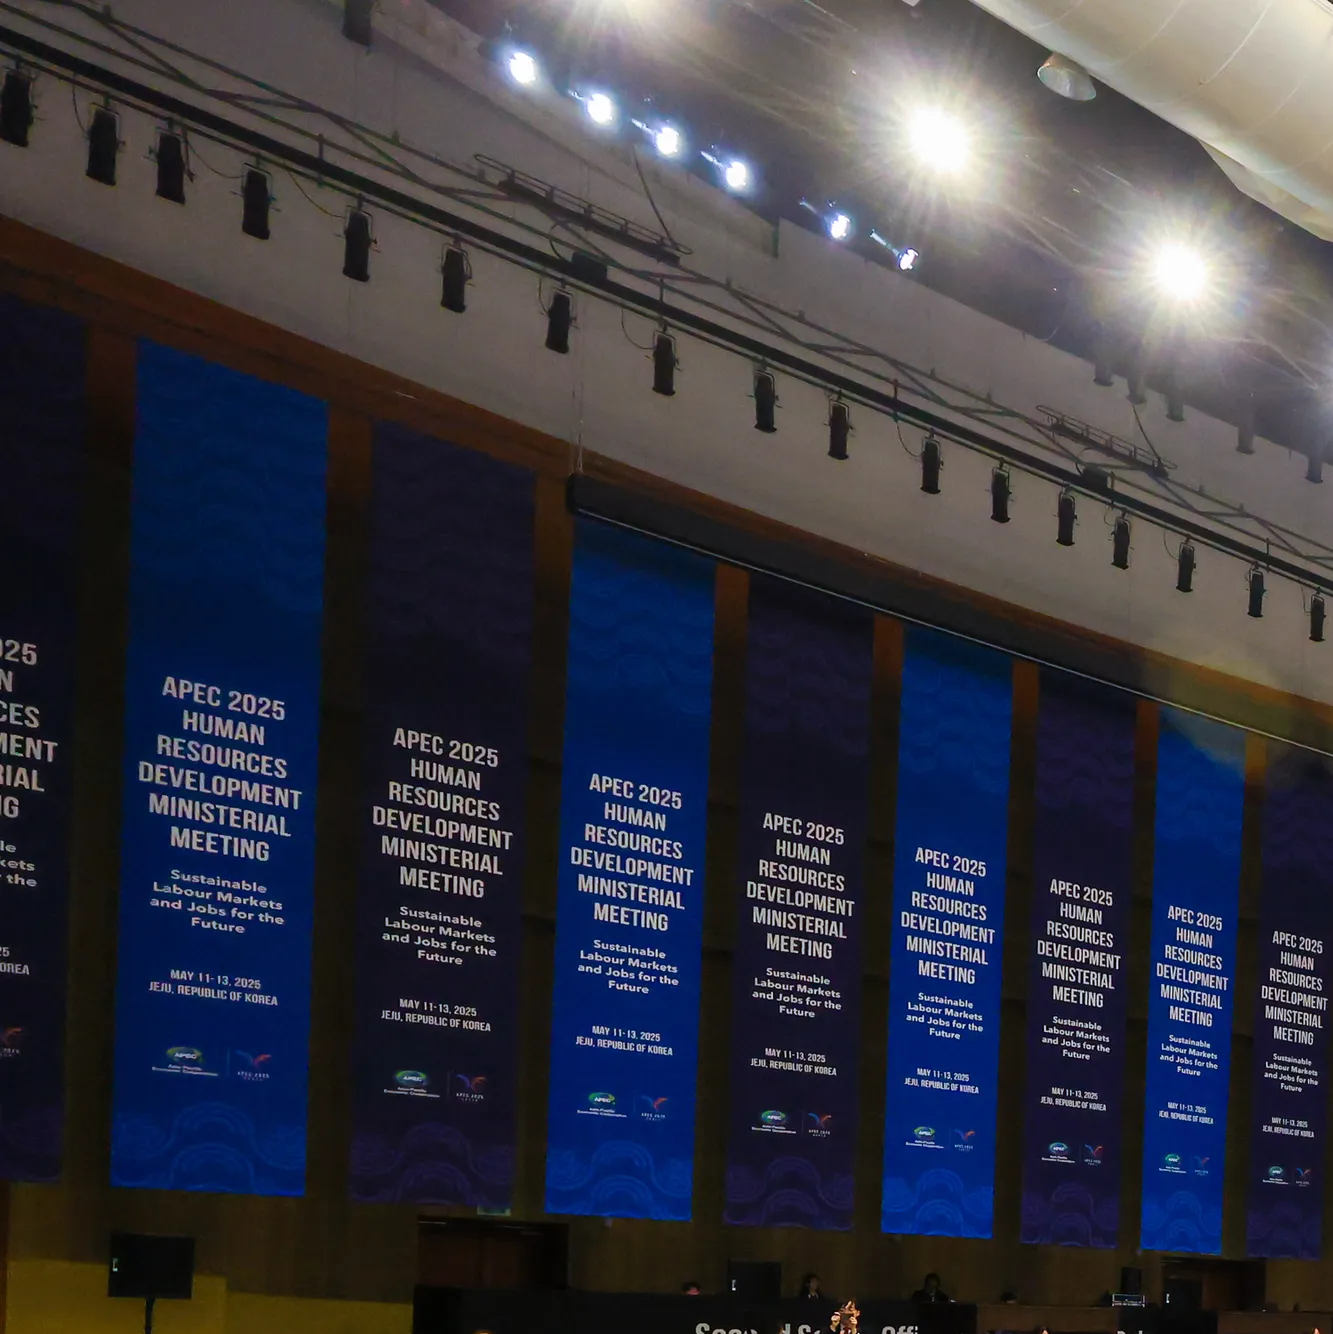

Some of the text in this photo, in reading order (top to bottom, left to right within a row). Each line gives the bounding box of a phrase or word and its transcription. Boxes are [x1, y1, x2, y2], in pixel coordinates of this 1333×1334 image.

[162, 676, 285, 720] APEC 2025
[183, 709, 265, 746] HUMAN
[157, 734, 287, 779] RESOURCES
[393, 728, 498, 767] APEC 2025
[139, 761, 302, 810] DEVELOPMENT
[411, 758, 480, 791] HUMAN
[389, 781, 500, 821] RESOURCES
[589, 773, 682, 809] APEC 2025
[149, 793, 291, 837] MINISTERIAL
[373, 806, 513, 850] DEVELOPMENT
[604, 802, 666, 832] HUMAN
[763, 813, 844, 845] APEC 2025
[170, 826, 270, 861] MEETING
[382, 835, 503, 875] MINISTERIAL
[585, 823, 682, 859] RESOURCES
[776, 839, 830, 866] HUMAN
[571, 846, 694, 886] DEVELOPMENT
[759, 859, 845, 892] RESOURCES
[915, 847, 986, 877] APEC 2025
[153, 881, 283, 910] Labour Markets
[171, 869, 267, 893] Sustainable
[400, 866, 484, 898] MEETING
[578, 874, 685, 910] MINISTERIAL
[927, 872, 974, 896] HUMAN
[1050, 879, 1113, 906] APEC 2025
[150, 898, 285, 925] and Jobs for the
[747, 881, 855, 917] DEVELOPMENT
[912, 891, 987, 921] RESOURCES
[1060, 902, 1102, 925] HUMAN
[191, 917, 245, 933] Future
[593, 902, 668, 931] MEETING
[753, 906, 847, 939] MINISTERIAL
[901, 911, 995, 944] DEVELOPMENT
[1167, 905, 1222, 931] APEC 2025
[767, 933, 832, 959] MEETING
[1047, 920, 1113, 948] RESOURCES
[1176, 927, 1213, 949] HUMAN
[1272, 931, 1323, 954] APEC 2025
[906, 935, 988, 965] MINISTERIAL
[1037, 941, 1121, 970] DEVELOPMENT
[1165, 944, 1222, 970] RESOURCES
[1280, 951, 1314, 971] HUMAN
[918, 960, 975, 984] MEETING
[1042, 962, 1115, 989] MINISTERIAL
[1156, 962, 1229, 991] DEVELOPMENT
[1269, 968, 1323, 991] RESOURCES
[1053, 985, 1103, 1008] MEETING
[1160, 984, 1222, 1009] MINISTERIAL
[1261, 985, 1328, 1011] DEVELOPMENT
[1169, 1005, 1213, 1027] MEETING
[1265, 1005, 1323, 1029] MINISTERIAL
[575, 1036, 673, 1056] JEJU, REPUBLIC OF KOREA
[1273, 1025, 1314, 1045] MEETING
